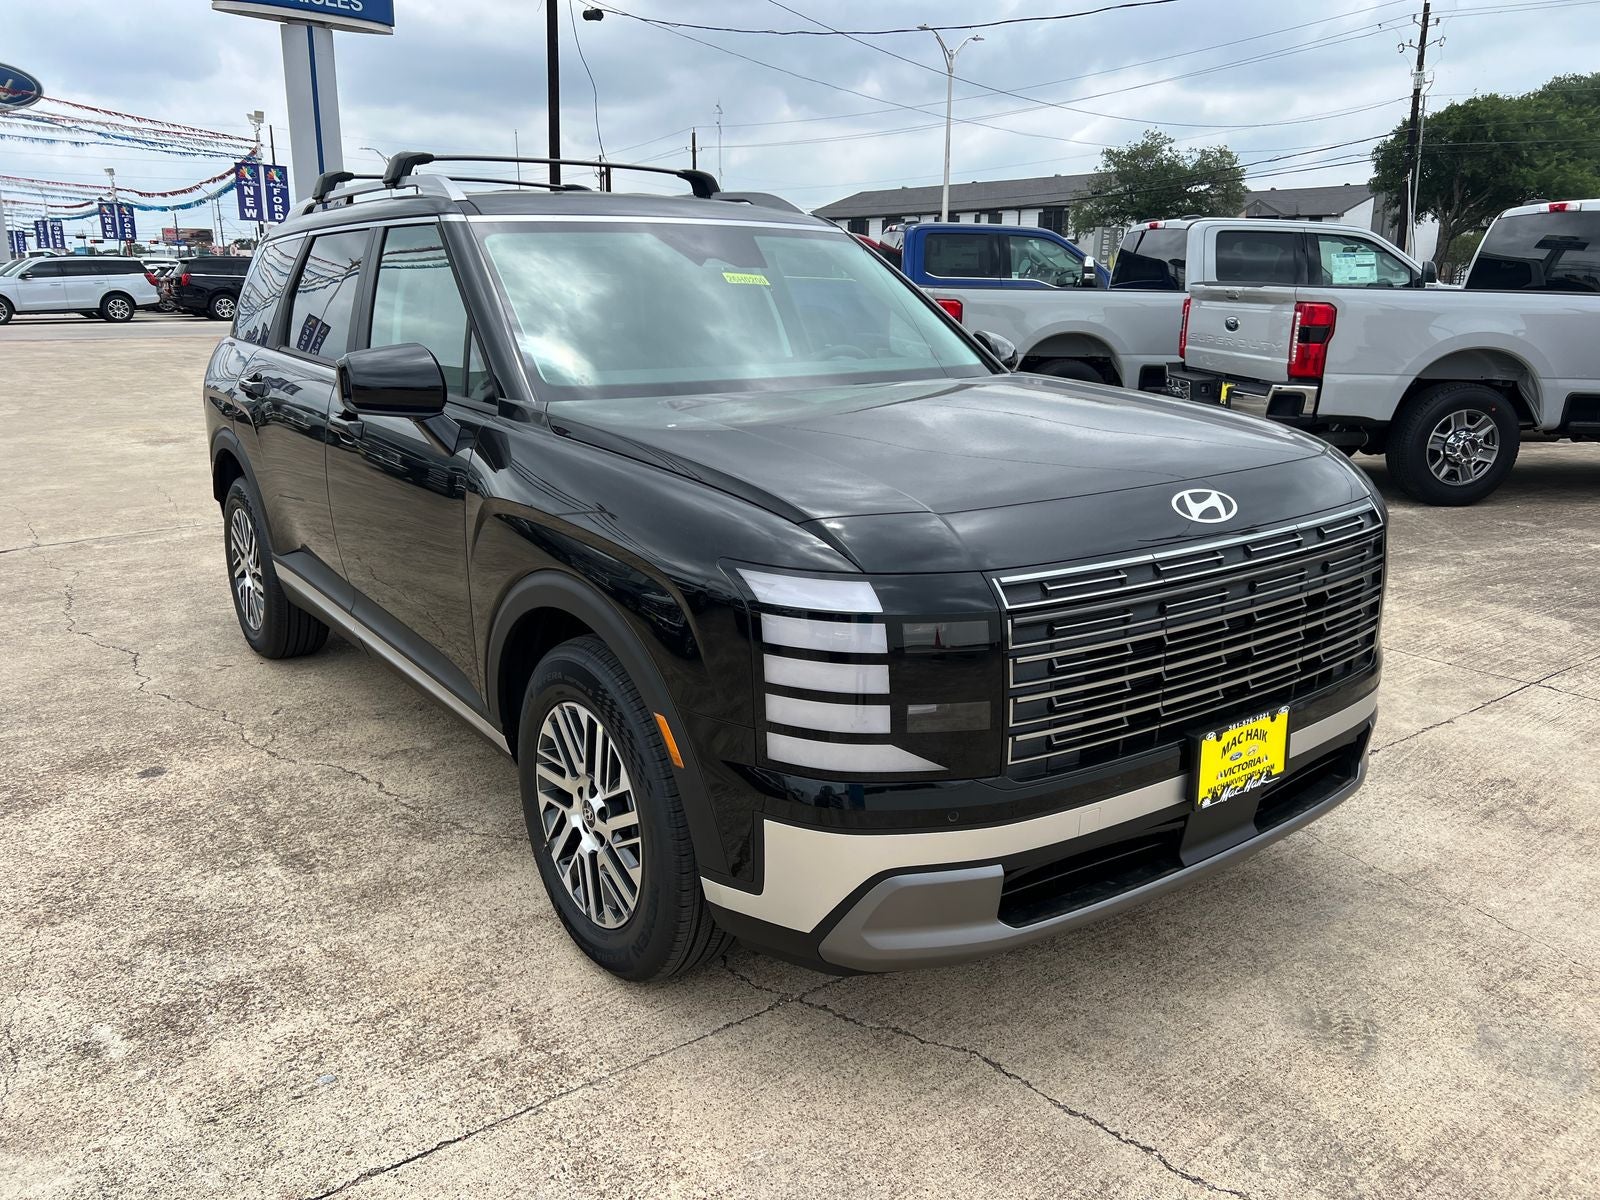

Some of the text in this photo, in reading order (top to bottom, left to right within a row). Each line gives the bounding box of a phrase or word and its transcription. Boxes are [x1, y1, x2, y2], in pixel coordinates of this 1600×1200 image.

[243, 185, 257, 218] NEW
[272, 188, 284, 220] FORD
[104, 217, 114, 238] NEW
[123, 217, 132, 239] FORD
[1102, 230, 1110, 255] GROVE
[1221, 731, 1244, 759] MAC
[1245, 728, 1268, 743] HAIK
[1223, 756, 1262, 778] VICTORIA
